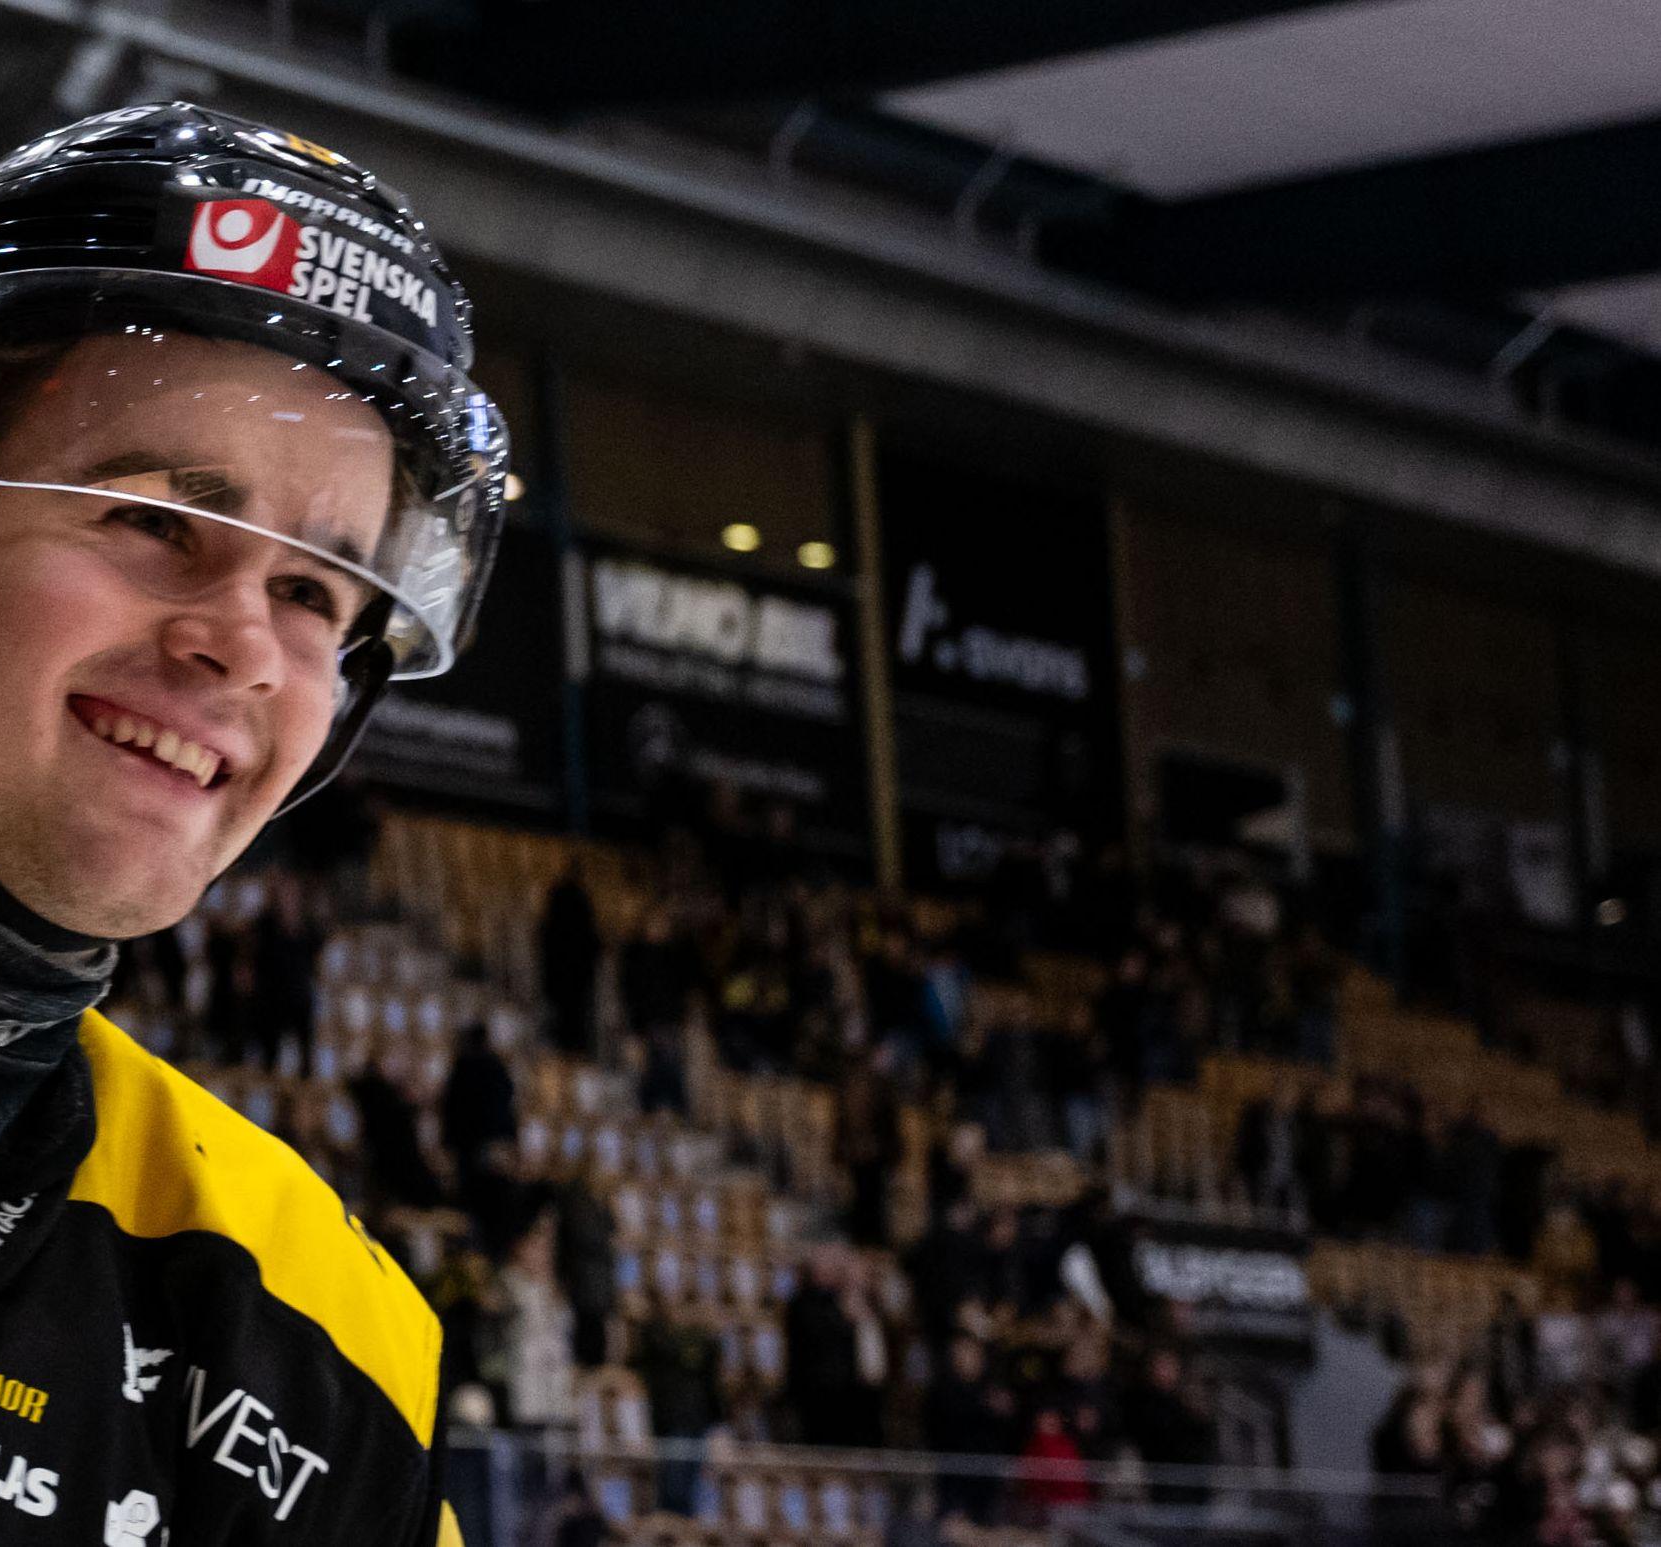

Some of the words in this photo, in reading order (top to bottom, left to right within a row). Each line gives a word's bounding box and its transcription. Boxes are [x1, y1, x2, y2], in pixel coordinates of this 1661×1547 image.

[288, 260, 373, 324] SPEL
[295, 225, 437, 328] SVENSKA
[183, 1364, 330, 1522] VEST
